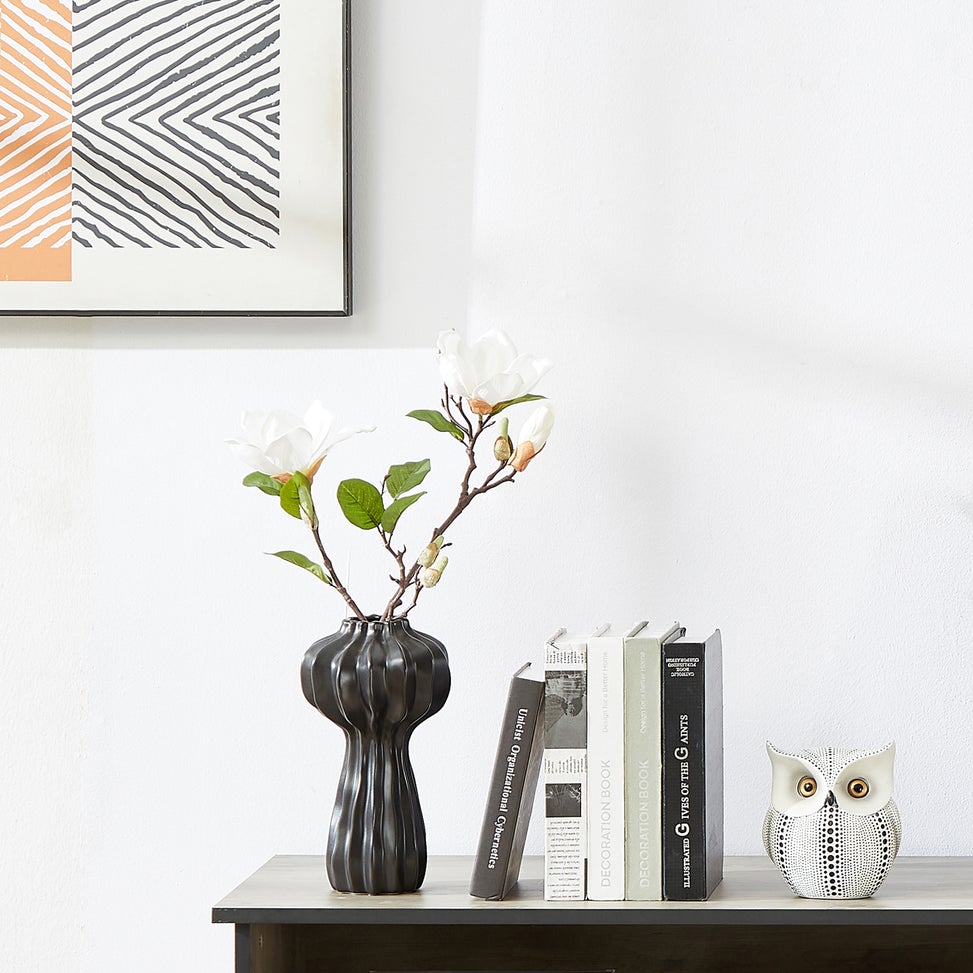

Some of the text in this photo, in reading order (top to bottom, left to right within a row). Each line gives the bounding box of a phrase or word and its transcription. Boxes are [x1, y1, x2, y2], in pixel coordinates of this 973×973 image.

[487, 708, 529, 869] Unicist Organizational Cybernetics
[600, 759, 611, 887] DECORATION BOOK
[639, 759, 649, 887] DECORATION BOOK
[680, 761, 689, 781] THE
[680, 782, 689, 796] OF
